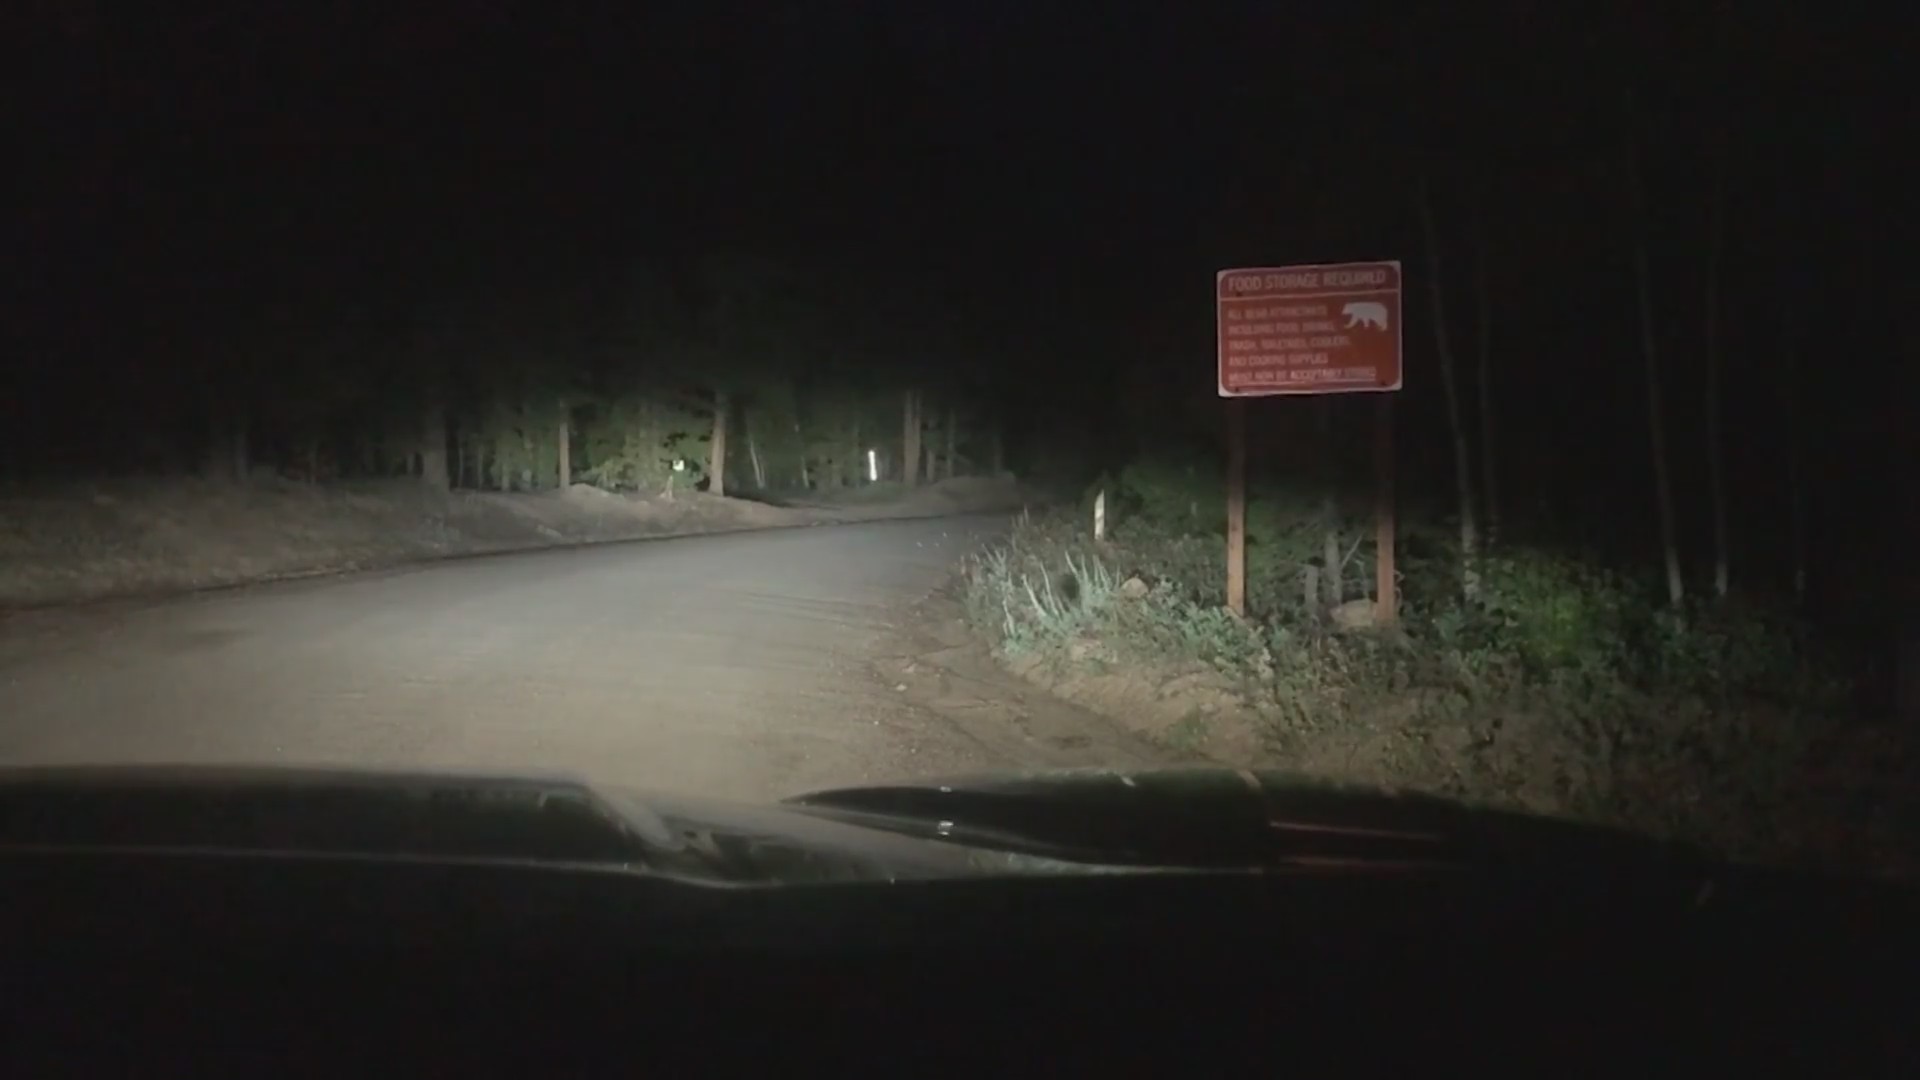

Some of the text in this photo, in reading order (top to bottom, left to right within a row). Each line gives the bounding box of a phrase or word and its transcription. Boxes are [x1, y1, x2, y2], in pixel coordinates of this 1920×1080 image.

[1228, 270, 1386, 291] FOOD STORAGE REQUIRED
[1228, 352, 1328, 366] AND COOKING SUPPLIES
